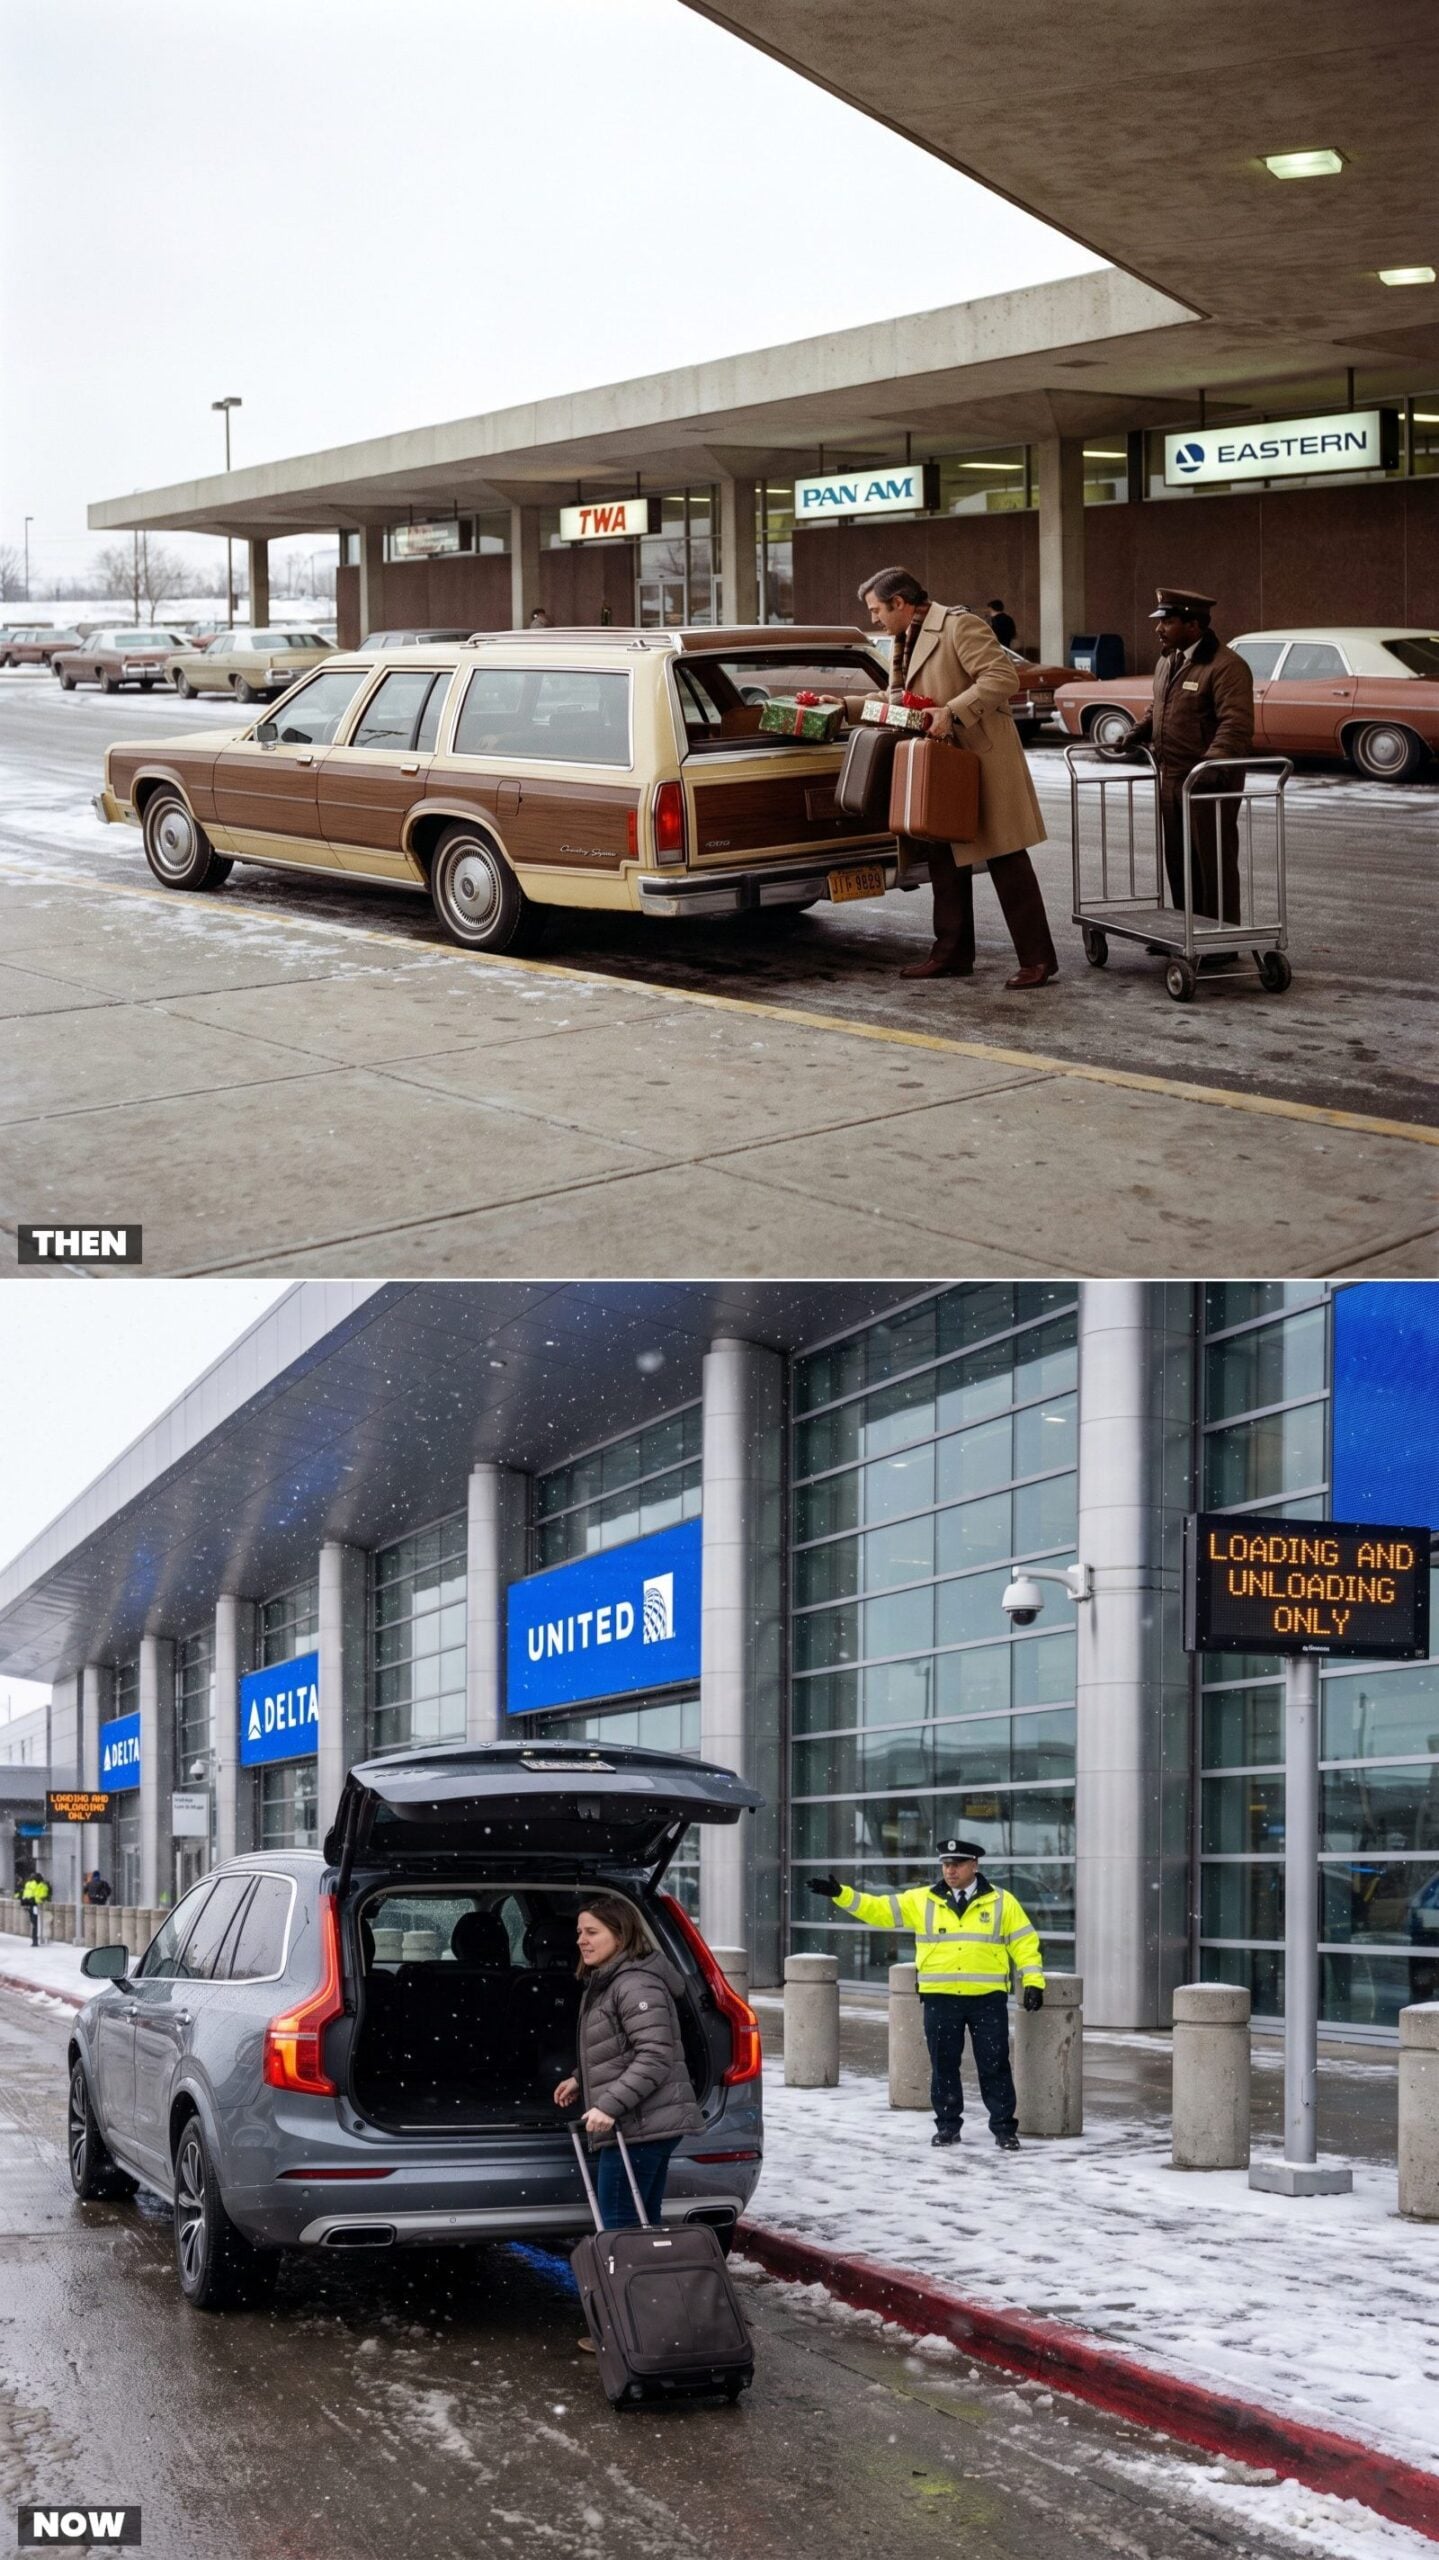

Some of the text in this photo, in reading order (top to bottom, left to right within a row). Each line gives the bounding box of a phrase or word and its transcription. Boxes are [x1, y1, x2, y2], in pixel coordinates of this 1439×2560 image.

[1217, 430, 1368, 464] EASTERN
[803, 477, 915, 509] PAN AM
[579, 505, 627, 535] TWA
[1209, 1532, 1415, 1571] LOADING AND
[1228, 1569, 1396, 1604] UNLOADING
[528, 1600, 635, 1662] UNITED
[1273, 1605, 1351, 1636] ONLY
[264, 1683, 319, 1734] DELTA
[111, 1736, 140, 1768] DELTA
[50, 1793, 109, 1803] LOADING AND
[67, 1811, 92, 1820] ONLY
